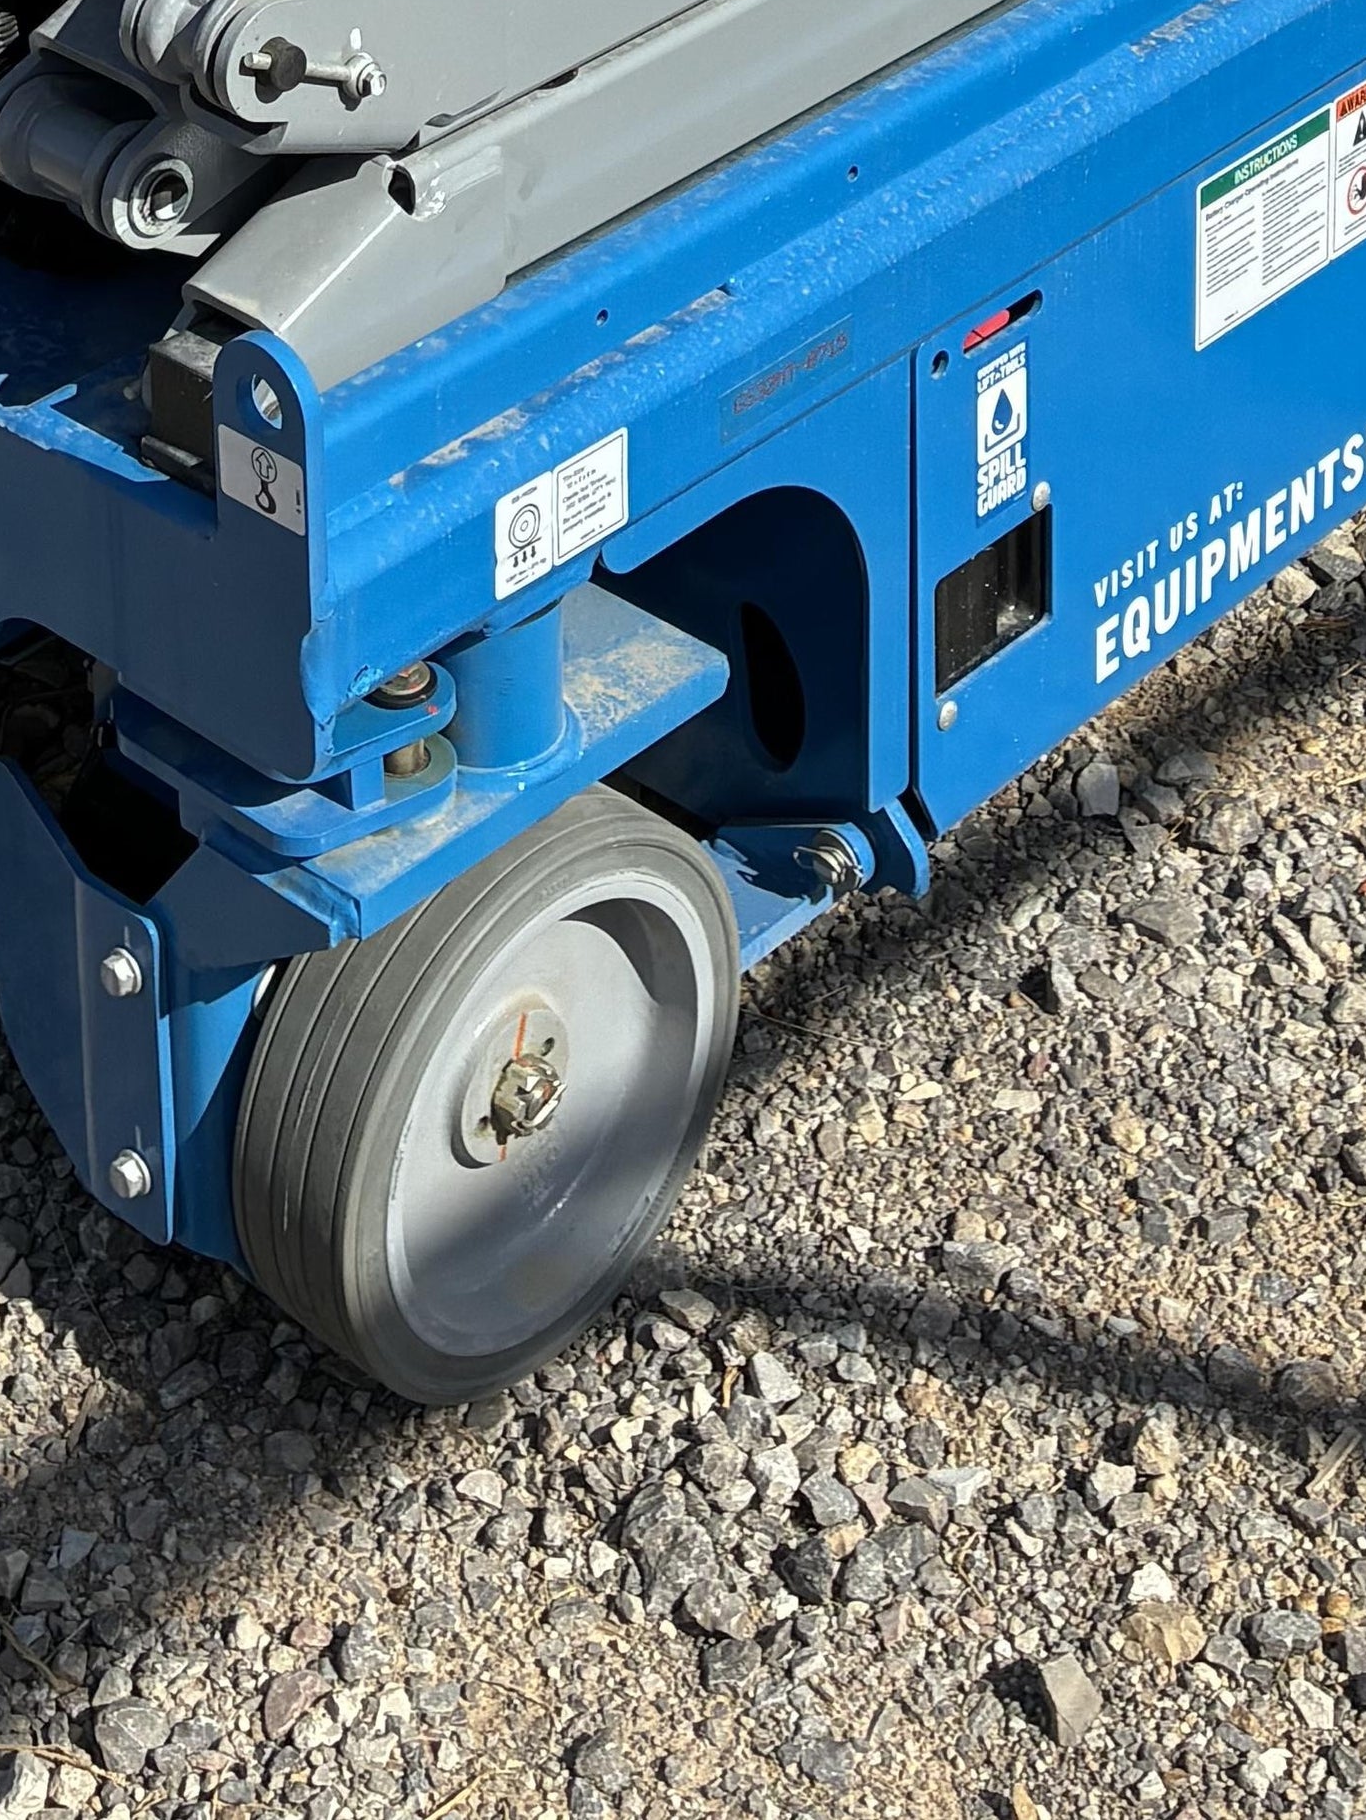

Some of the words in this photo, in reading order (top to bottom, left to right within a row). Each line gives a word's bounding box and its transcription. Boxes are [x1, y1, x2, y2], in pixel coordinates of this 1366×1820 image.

[1234, 134, 1298, 185] INSTRUCTIONS
[977, 441, 1026, 496] SPILL
[977, 467, 1026, 518] GUARD
[1094, 539, 1158, 608] VISIT
[1170, 512, 1200, 555] US
[1208, 481, 1245, 532] AT:
